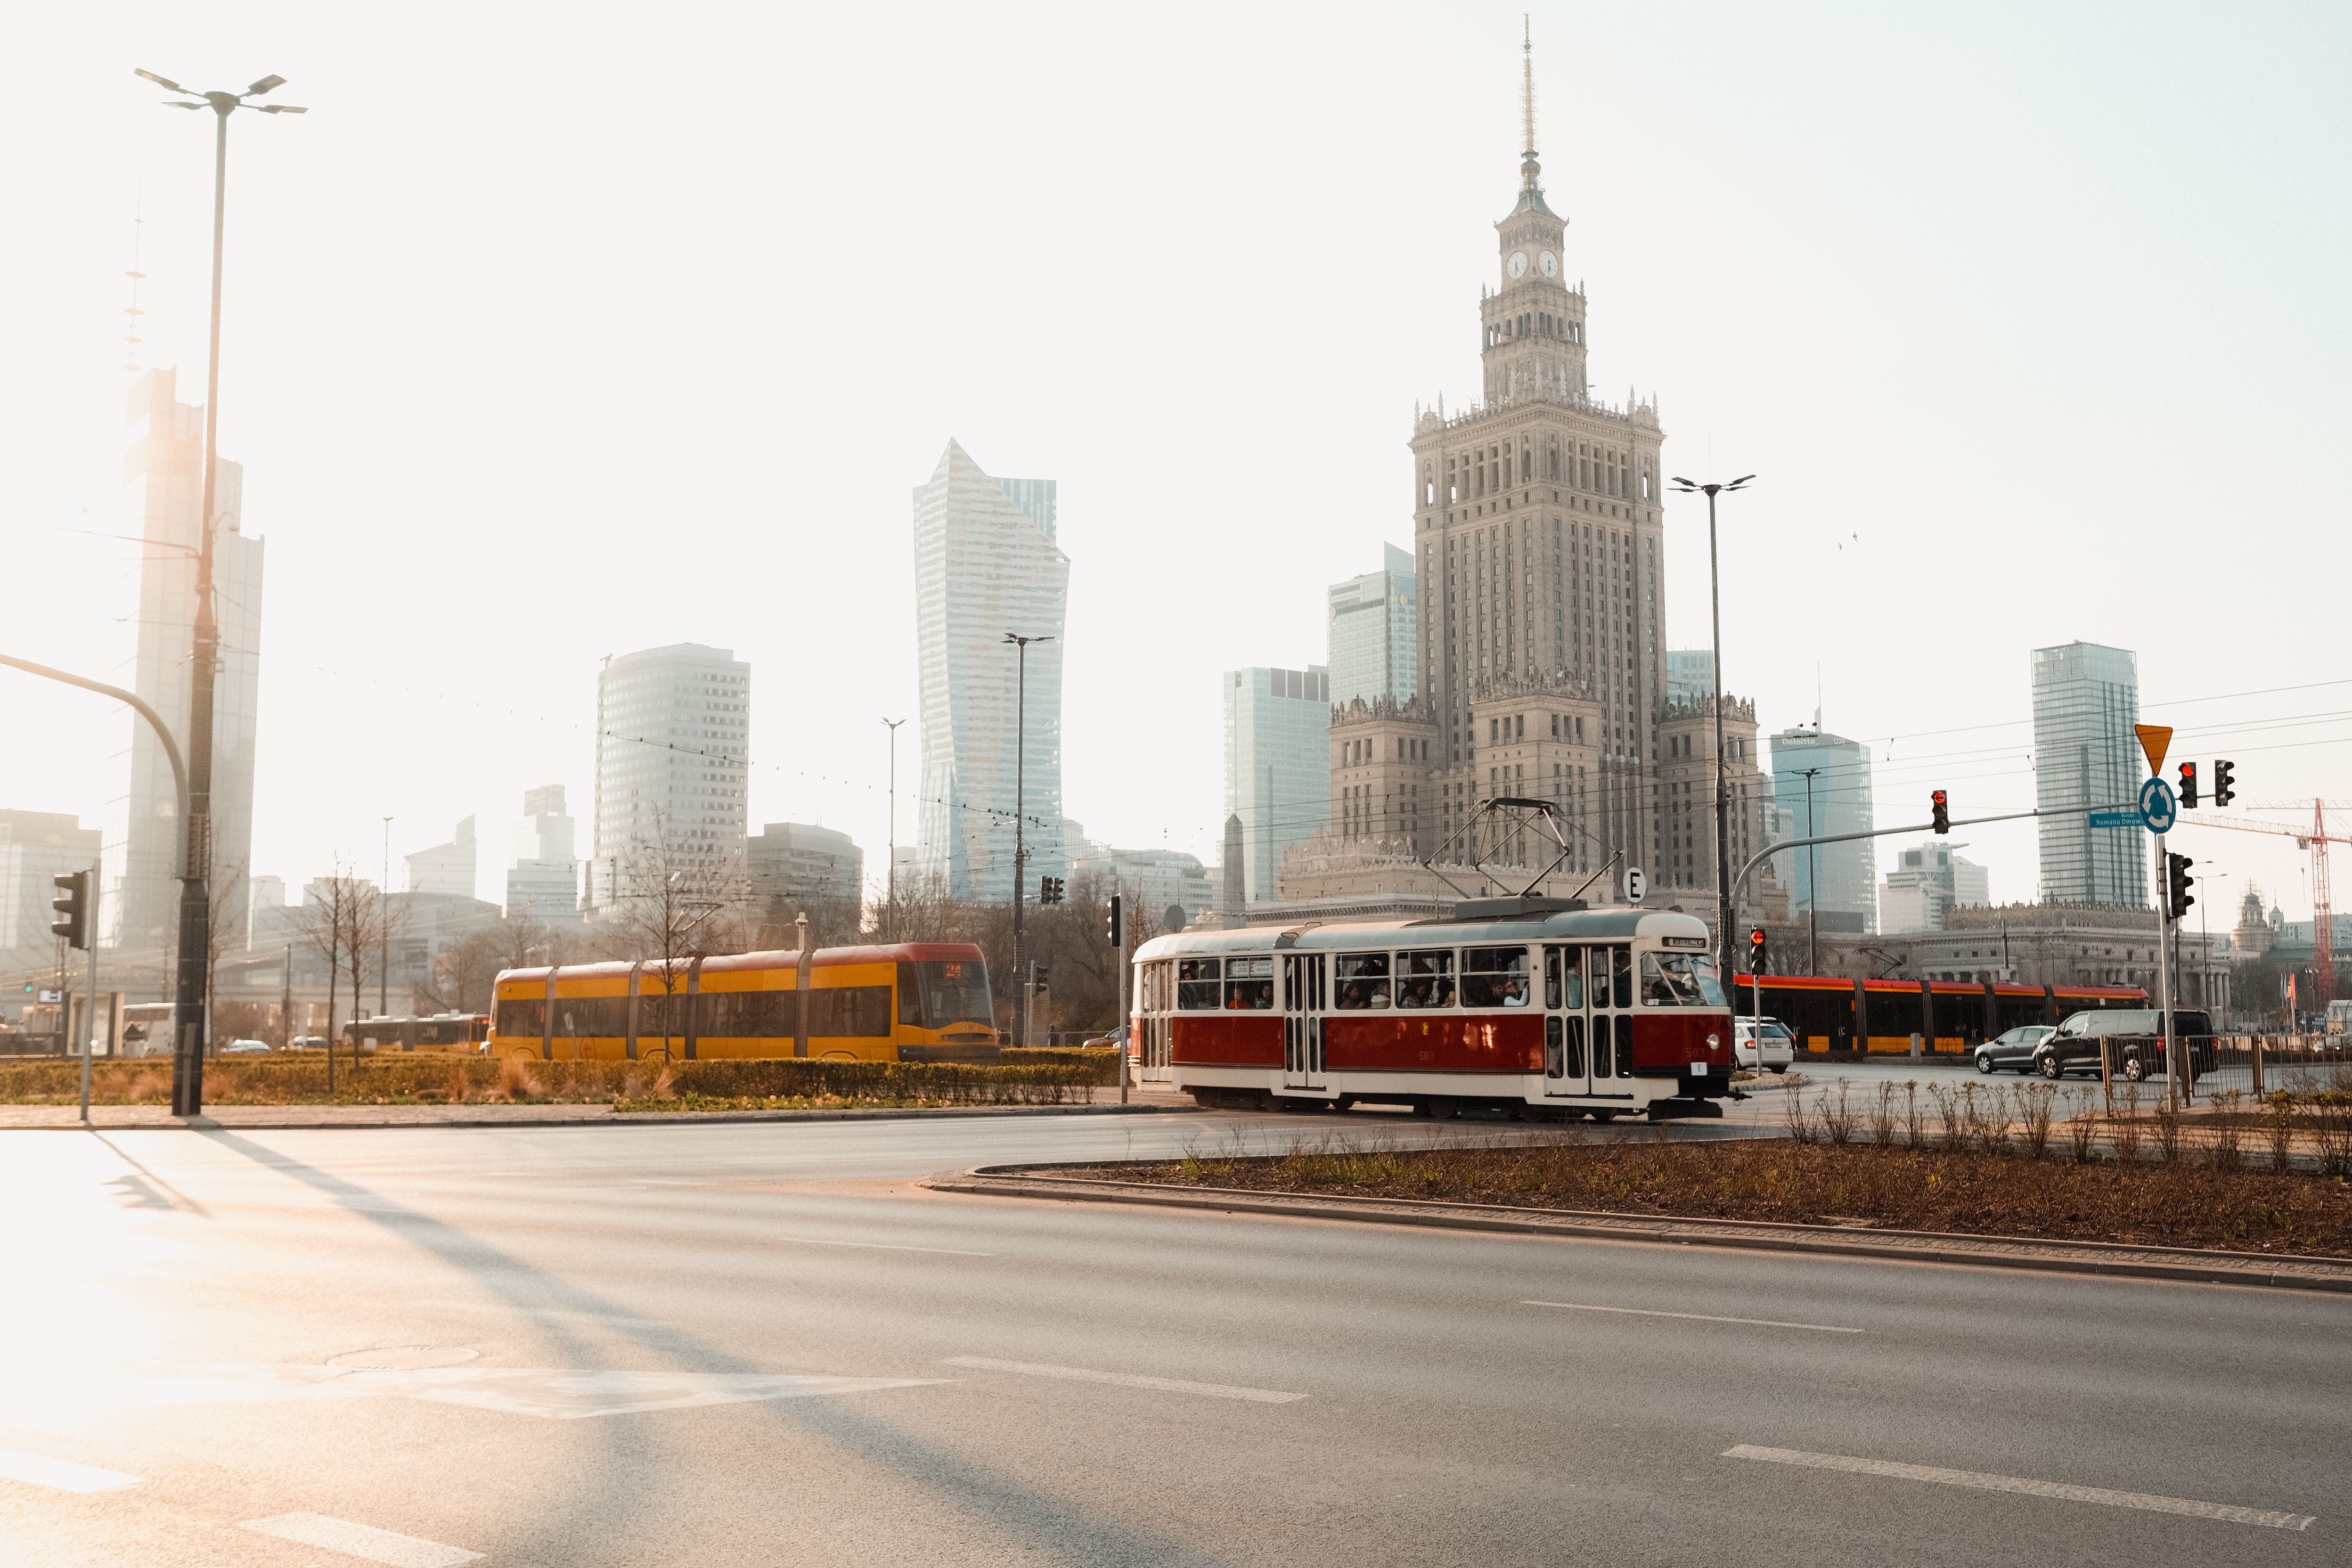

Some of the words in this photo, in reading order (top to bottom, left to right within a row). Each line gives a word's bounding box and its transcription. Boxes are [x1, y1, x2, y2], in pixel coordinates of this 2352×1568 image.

[1155, 860, 1197, 869] accenture
[1630, 872, 1640, 898] E
[1686, 1047, 1704, 1058] 503
